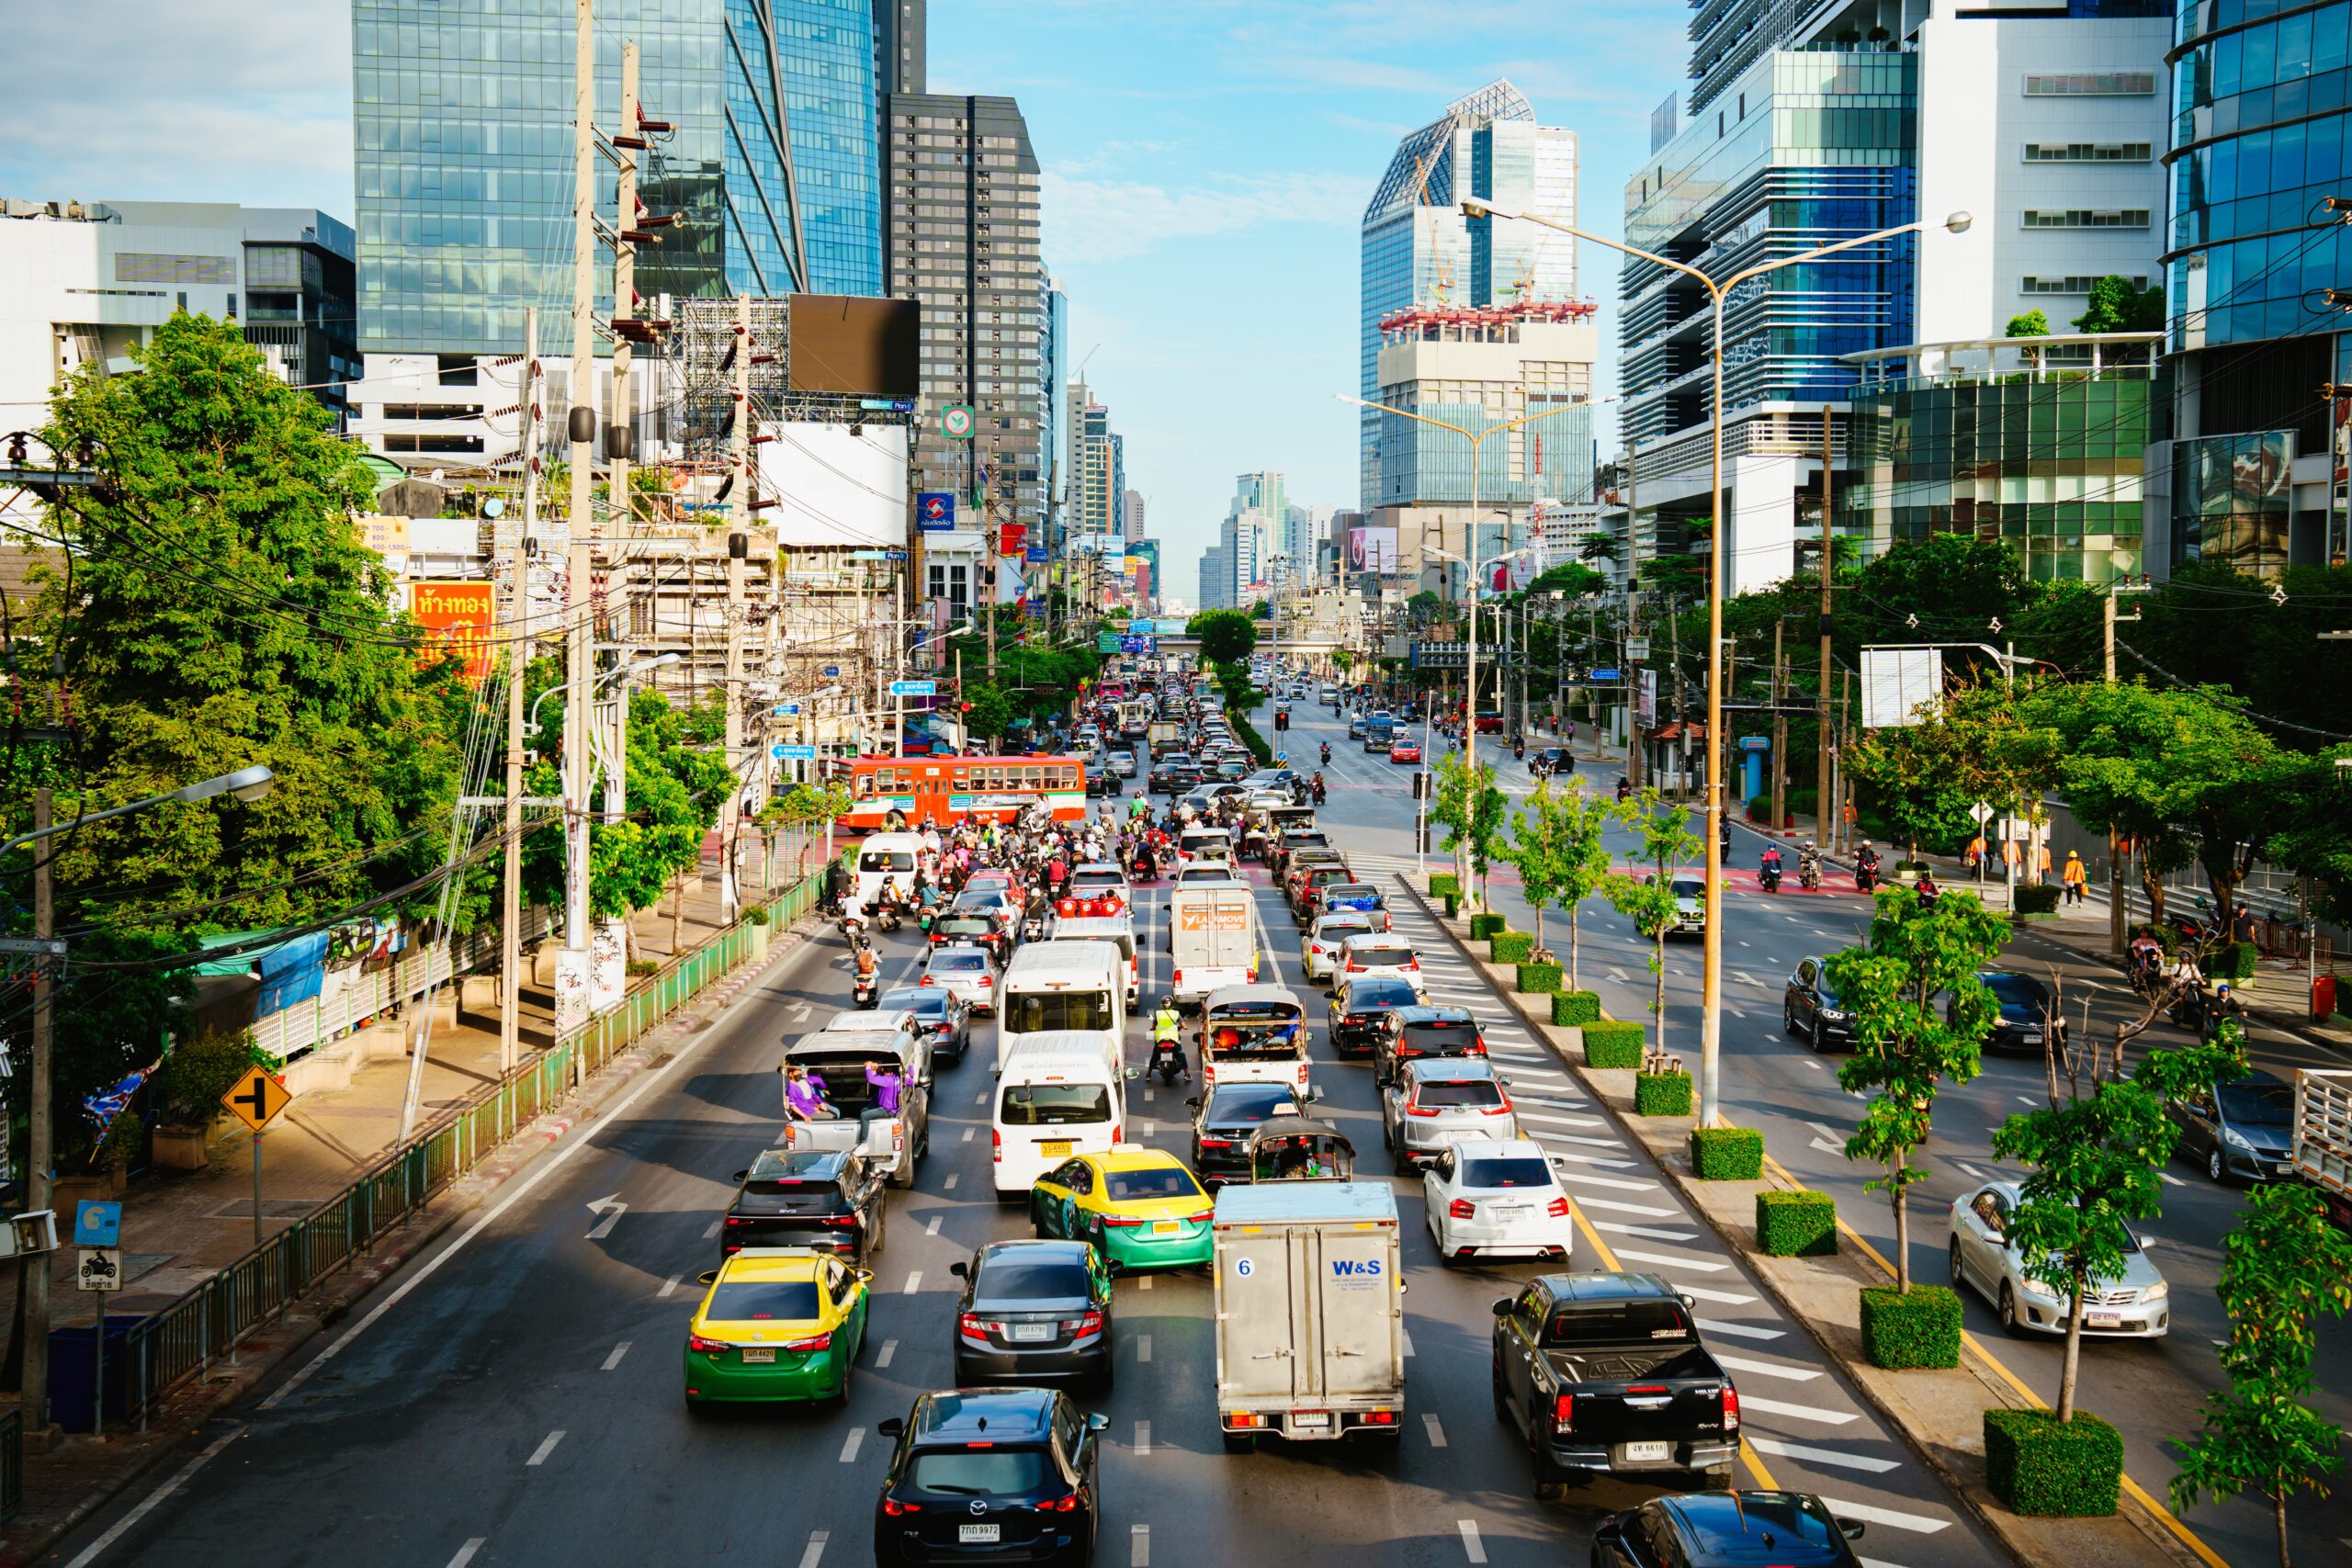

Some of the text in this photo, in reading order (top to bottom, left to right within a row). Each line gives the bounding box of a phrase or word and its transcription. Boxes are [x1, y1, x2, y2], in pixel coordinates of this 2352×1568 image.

[418, 589, 489, 615] ห้างทอง
[1238, 1259, 1250, 1276] 6
[978, 1526, 999, 1535] 9972
